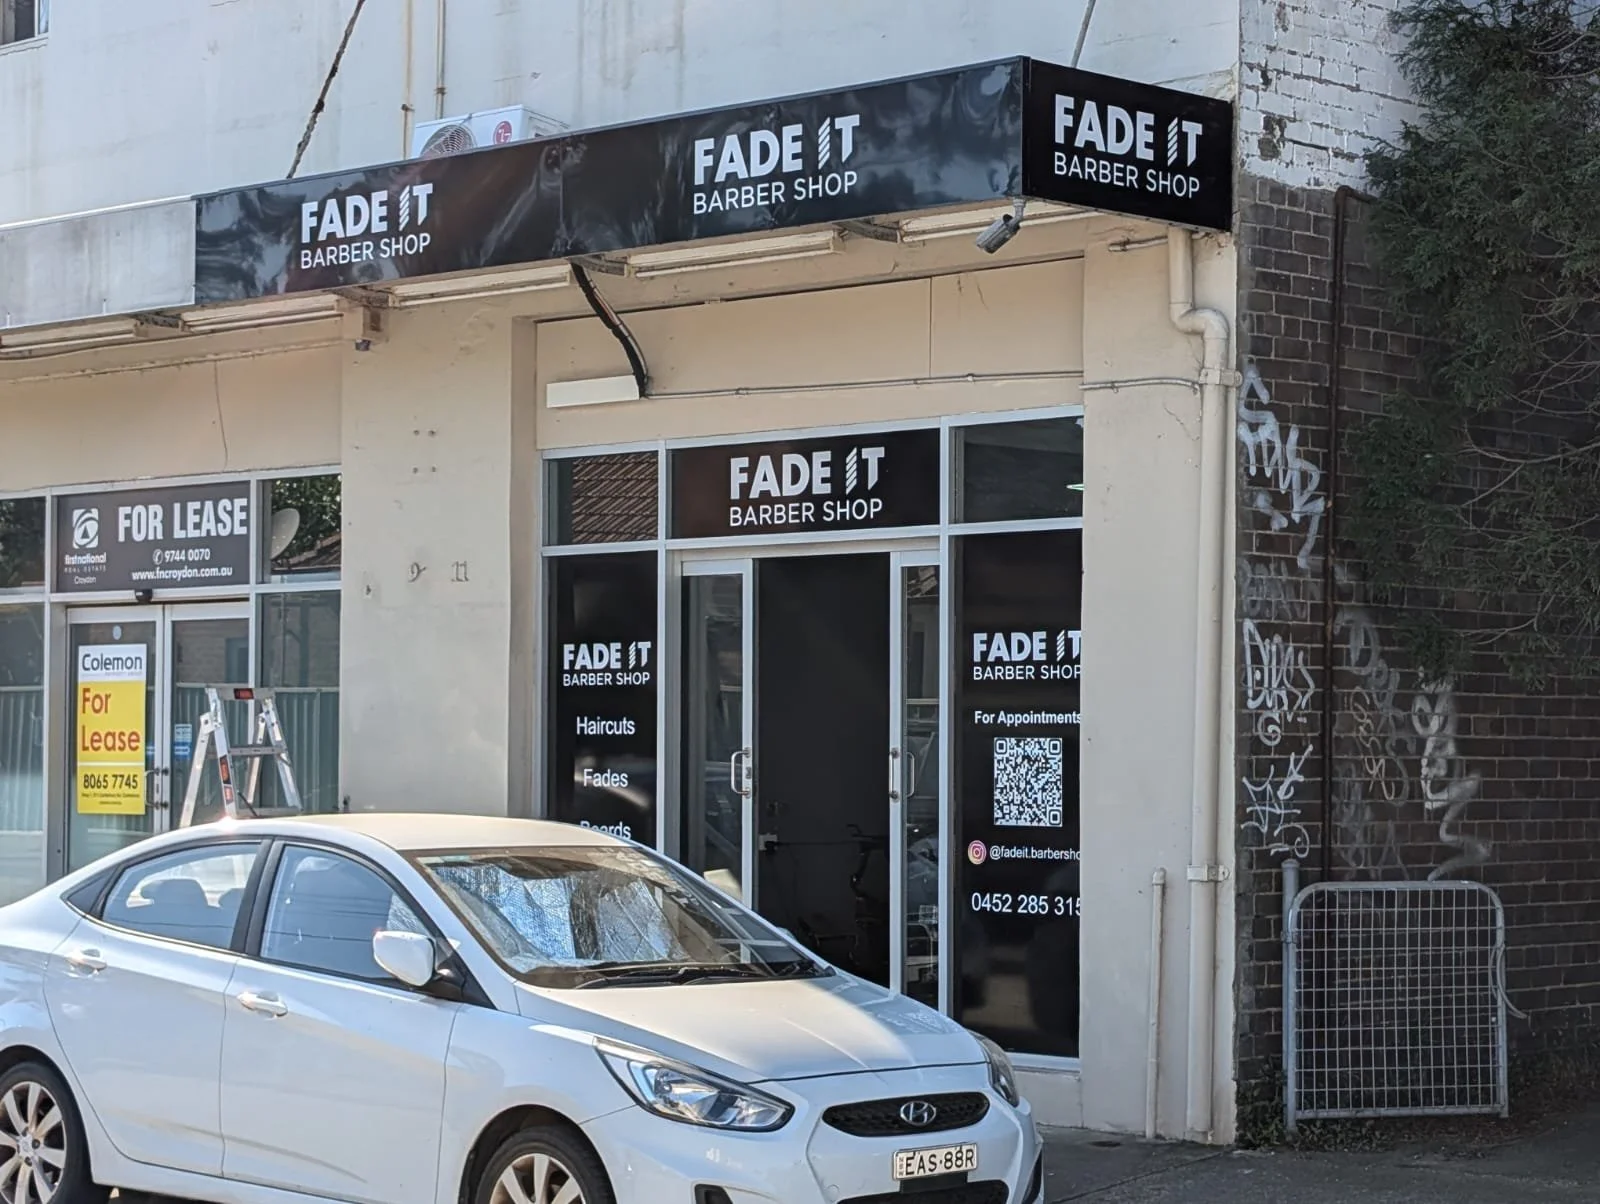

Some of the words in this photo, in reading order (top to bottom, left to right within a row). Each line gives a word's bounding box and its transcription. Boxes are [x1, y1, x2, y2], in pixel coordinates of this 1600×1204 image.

[1054, 93, 1154, 161] FADE
[1167, 117, 1203, 167] IT
[694, 123, 803, 186] FADE
[818, 114, 860, 170] IT
[1054, 151, 1139, 189] BARBER
[1146, 169, 1200, 199] SHOP
[693, 181, 785, 215] BARBER
[793, 171, 857, 201] SHOP
[301, 190, 388, 244] FADE
[399, 183, 433, 231] IT
[301, 241, 374, 269] BARBER
[380, 233, 431, 258] SHOP
[730, 450, 832, 500] FADE
[845, 446, 885, 495] IT
[118, 504, 163, 542] FOR
[173, 498, 248, 538] LEASE
[729, 502, 815, 527] BARBER
[823, 498, 883, 521] SHOP
[164, 550, 186, 563] 9744
[188, 548, 210, 561] 0070
[132, 566, 233, 582] www.fncroydon.com.au
[563, 642, 622, 670] FADE
[628, 641, 652, 670] IT
[973, 631, 1047, 662] FADE
[82, 653, 143, 671] Colemon
[973, 665, 1036, 680] BARBER
[1040, 664, 1081, 680] SHOP
[563, 673, 612, 687] BARBER
[616, 671, 650, 686] SHOP
[82, 687, 112, 714] For
[576, 716, 636, 736] Haircuts
[974, 710, 995, 724] For
[997, 710, 1081, 727] Appointments
[82, 725, 141, 752] Lease
[83, 774, 109, 789] 8065
[112, 774, 138, 789] 7745
[583, 768, 629, 788] Fades
[971, 892, 1013, 913] 0452
[1017, 894, 1049, 915] 285
